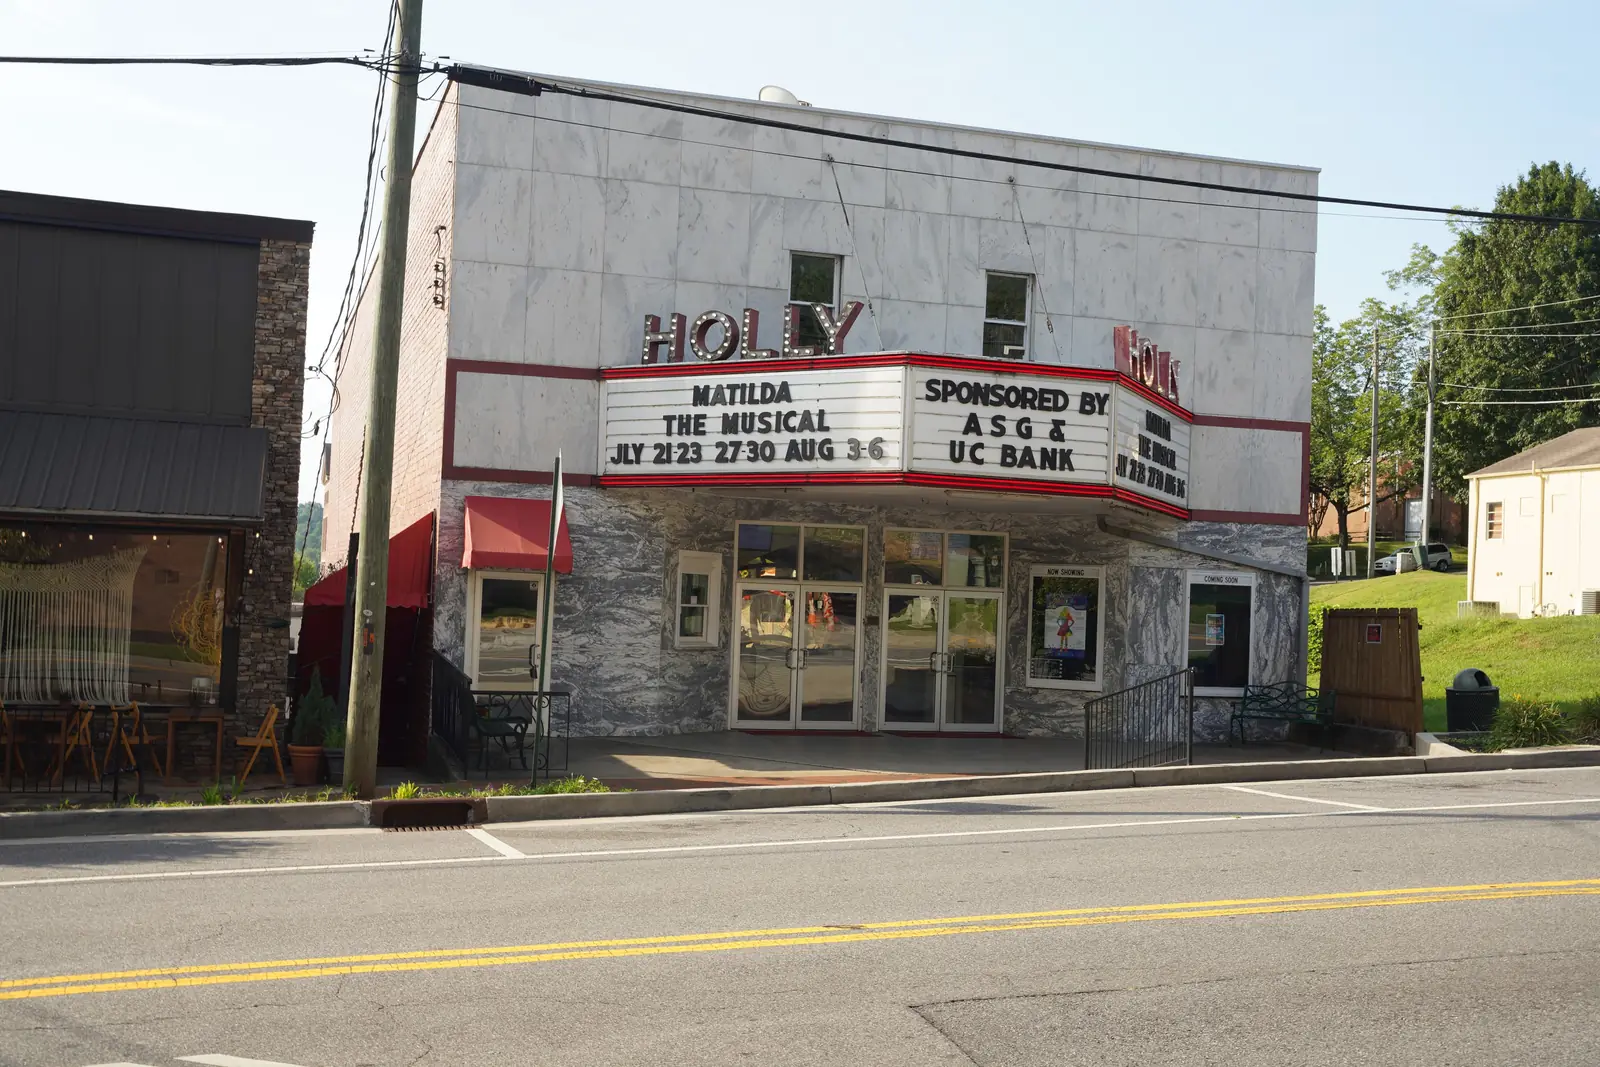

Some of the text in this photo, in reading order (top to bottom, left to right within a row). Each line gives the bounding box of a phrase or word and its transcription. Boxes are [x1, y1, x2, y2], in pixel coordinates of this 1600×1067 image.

[642, 301, 864, 364] HOLLY
[692, 381, 792, 407] MATILDA
[925, 379, 1109, 416] SPONSORED BY
[662, 409, 830, 437] THE MUSICAL
[1050, 419, 1066, 442] &
[610, 437, 884, 464] JLY 21-23 27-30 AUG 3-6
[949, 440, 1075, 471] UC BANK
[1138, 433, 1151, 460] THE
[1047, 568, 1085, 577] NOW SHOWING
[1203, 575, 1239, 584] COMING SOON
